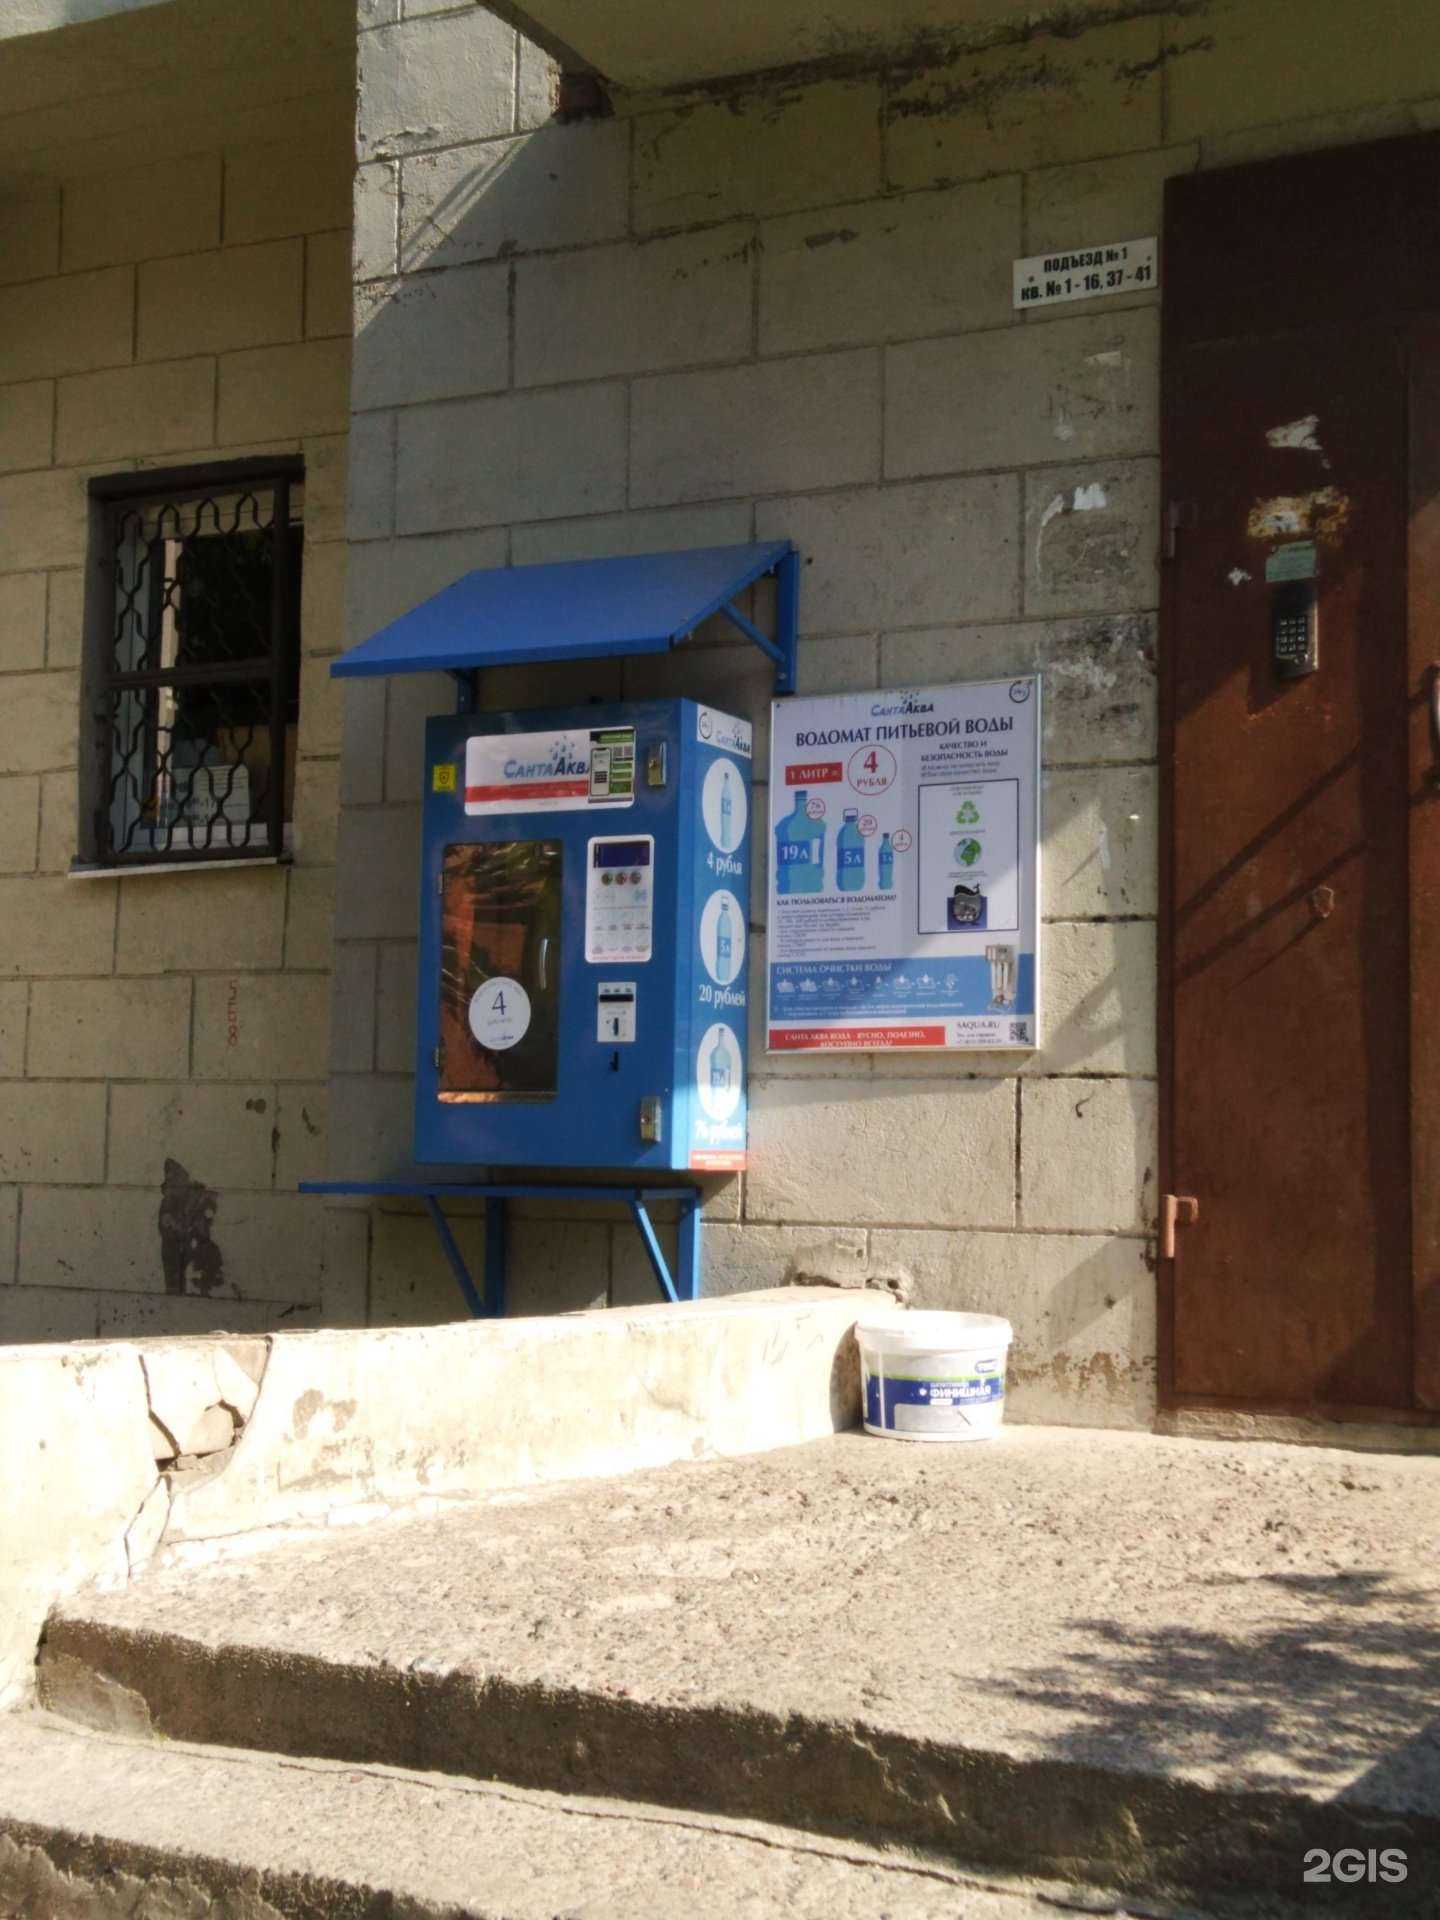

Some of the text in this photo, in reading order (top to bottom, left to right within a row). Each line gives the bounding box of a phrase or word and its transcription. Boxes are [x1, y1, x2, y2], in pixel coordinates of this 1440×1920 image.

[1044, 247, 1128, 273] ПОДЪЕЗД № 1
[1046, 280, 1062, 297] №
[1065, 278, 1072, 294] 1
[1106, 269, 1124, 287] 37
[1134, 265, 1152, 282] 41
[796, 716, 1014, 747] ВОДОМАТ ПИТЬЕВОЙ ВОДЫ
[920, 751, 983, 762] БЕЗОПАСНОСТЬ
[939, 740, 979, 750] КАЧЕСТВО
[503, 756, 589, 779] САНТААКВ
[800, 767, 829, 779] ЛИТР
[863, 751, 879, 773] 4
[857, 777, 887, 788] РУБЛЯ
[706, 852, 743, 877] 4 рубля
[491, 990, 507, 1015] 4
[698, 983, 746, 1009] 20 рублей
